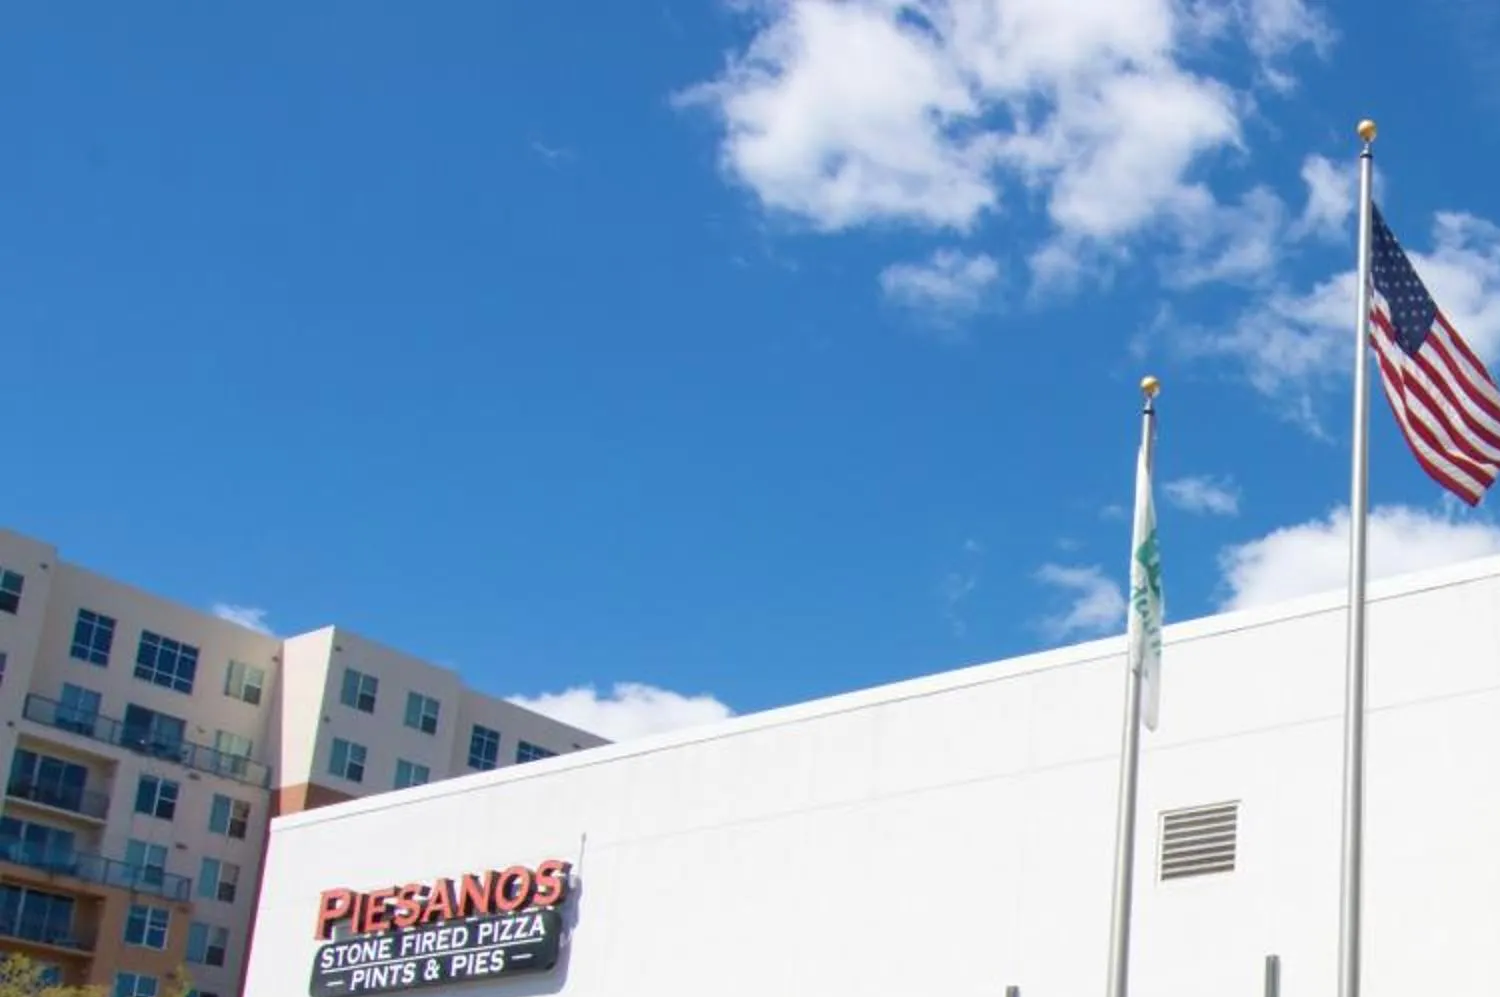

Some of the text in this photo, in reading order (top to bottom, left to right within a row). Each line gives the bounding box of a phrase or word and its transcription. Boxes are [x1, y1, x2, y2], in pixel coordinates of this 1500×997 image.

[314, 859, 571, 940] PIESANOS
[320, 915, 546, 969] STONE FIRED PIZZA
[349, 950, 504, 991] PINTS & PIES
